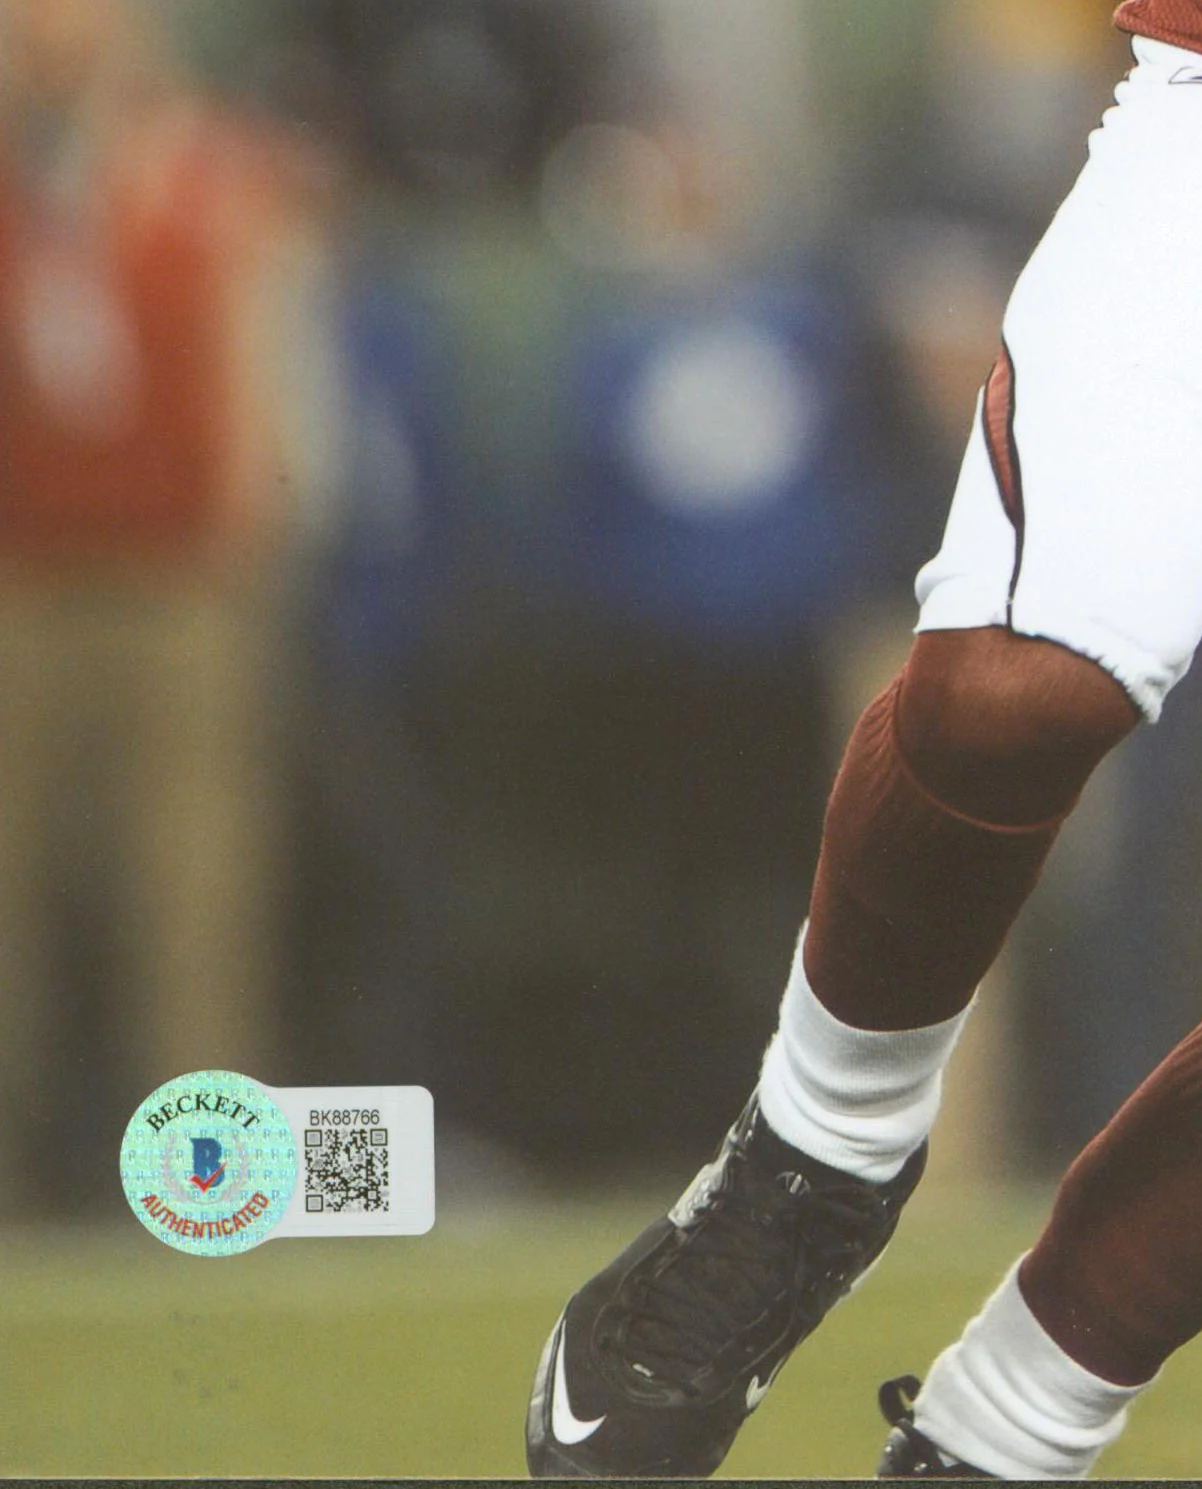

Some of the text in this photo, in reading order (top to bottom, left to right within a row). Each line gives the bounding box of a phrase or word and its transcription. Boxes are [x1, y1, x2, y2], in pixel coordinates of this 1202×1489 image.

[145, 1092, 261, 1133] BECKETT
[309, 1109, 381, 1127] BK88766
[139, 1191, 270, 1240] AUTHENTICATED
